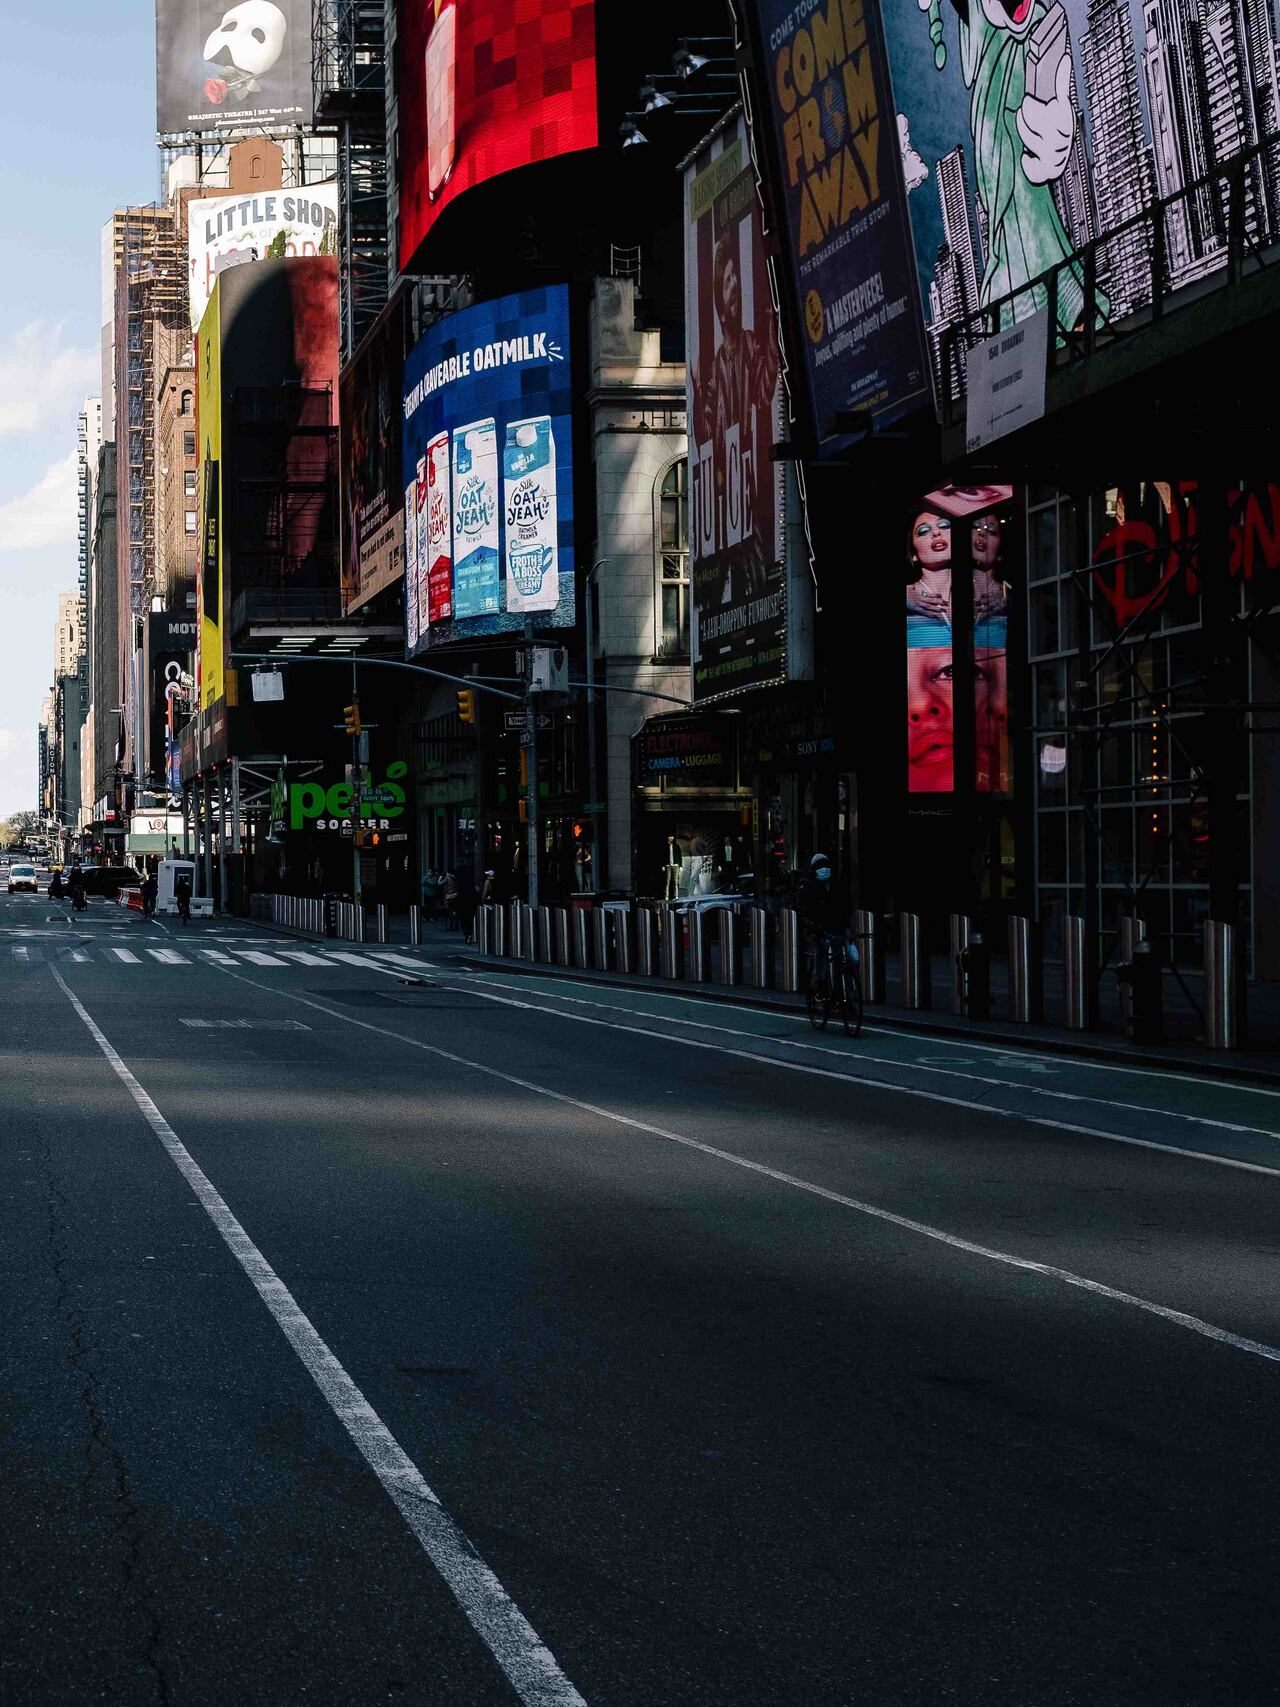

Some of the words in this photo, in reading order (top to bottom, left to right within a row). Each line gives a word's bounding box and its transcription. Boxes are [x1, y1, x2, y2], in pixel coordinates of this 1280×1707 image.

[770, 14, 794, 51] COME
[776, 0, 867, 113] COME
[799, 118, 880, 257] AWAY
[206, 197, 277, 244] LITTLE
[283, 197, 336, 228] SHOP
[850, 219, 868, 240] TRUE
[868, 200, 891, 227] STORY
[473, 332, 548, 372] OATMILK
[637, 409, 681, 427] THE
[461, 482, 485, 509] OAT
[514, 485, 540, 506] OAT
[519, 480, 535, 493] Silk
[456, 503, 489, 535] YEAH
[508, 502, 545, 526] YEAH
[512, 555, 538, 569] FROTH
[521, 566, 542, 577] BOSS
[648, 756, 681, 769] CAMERA
